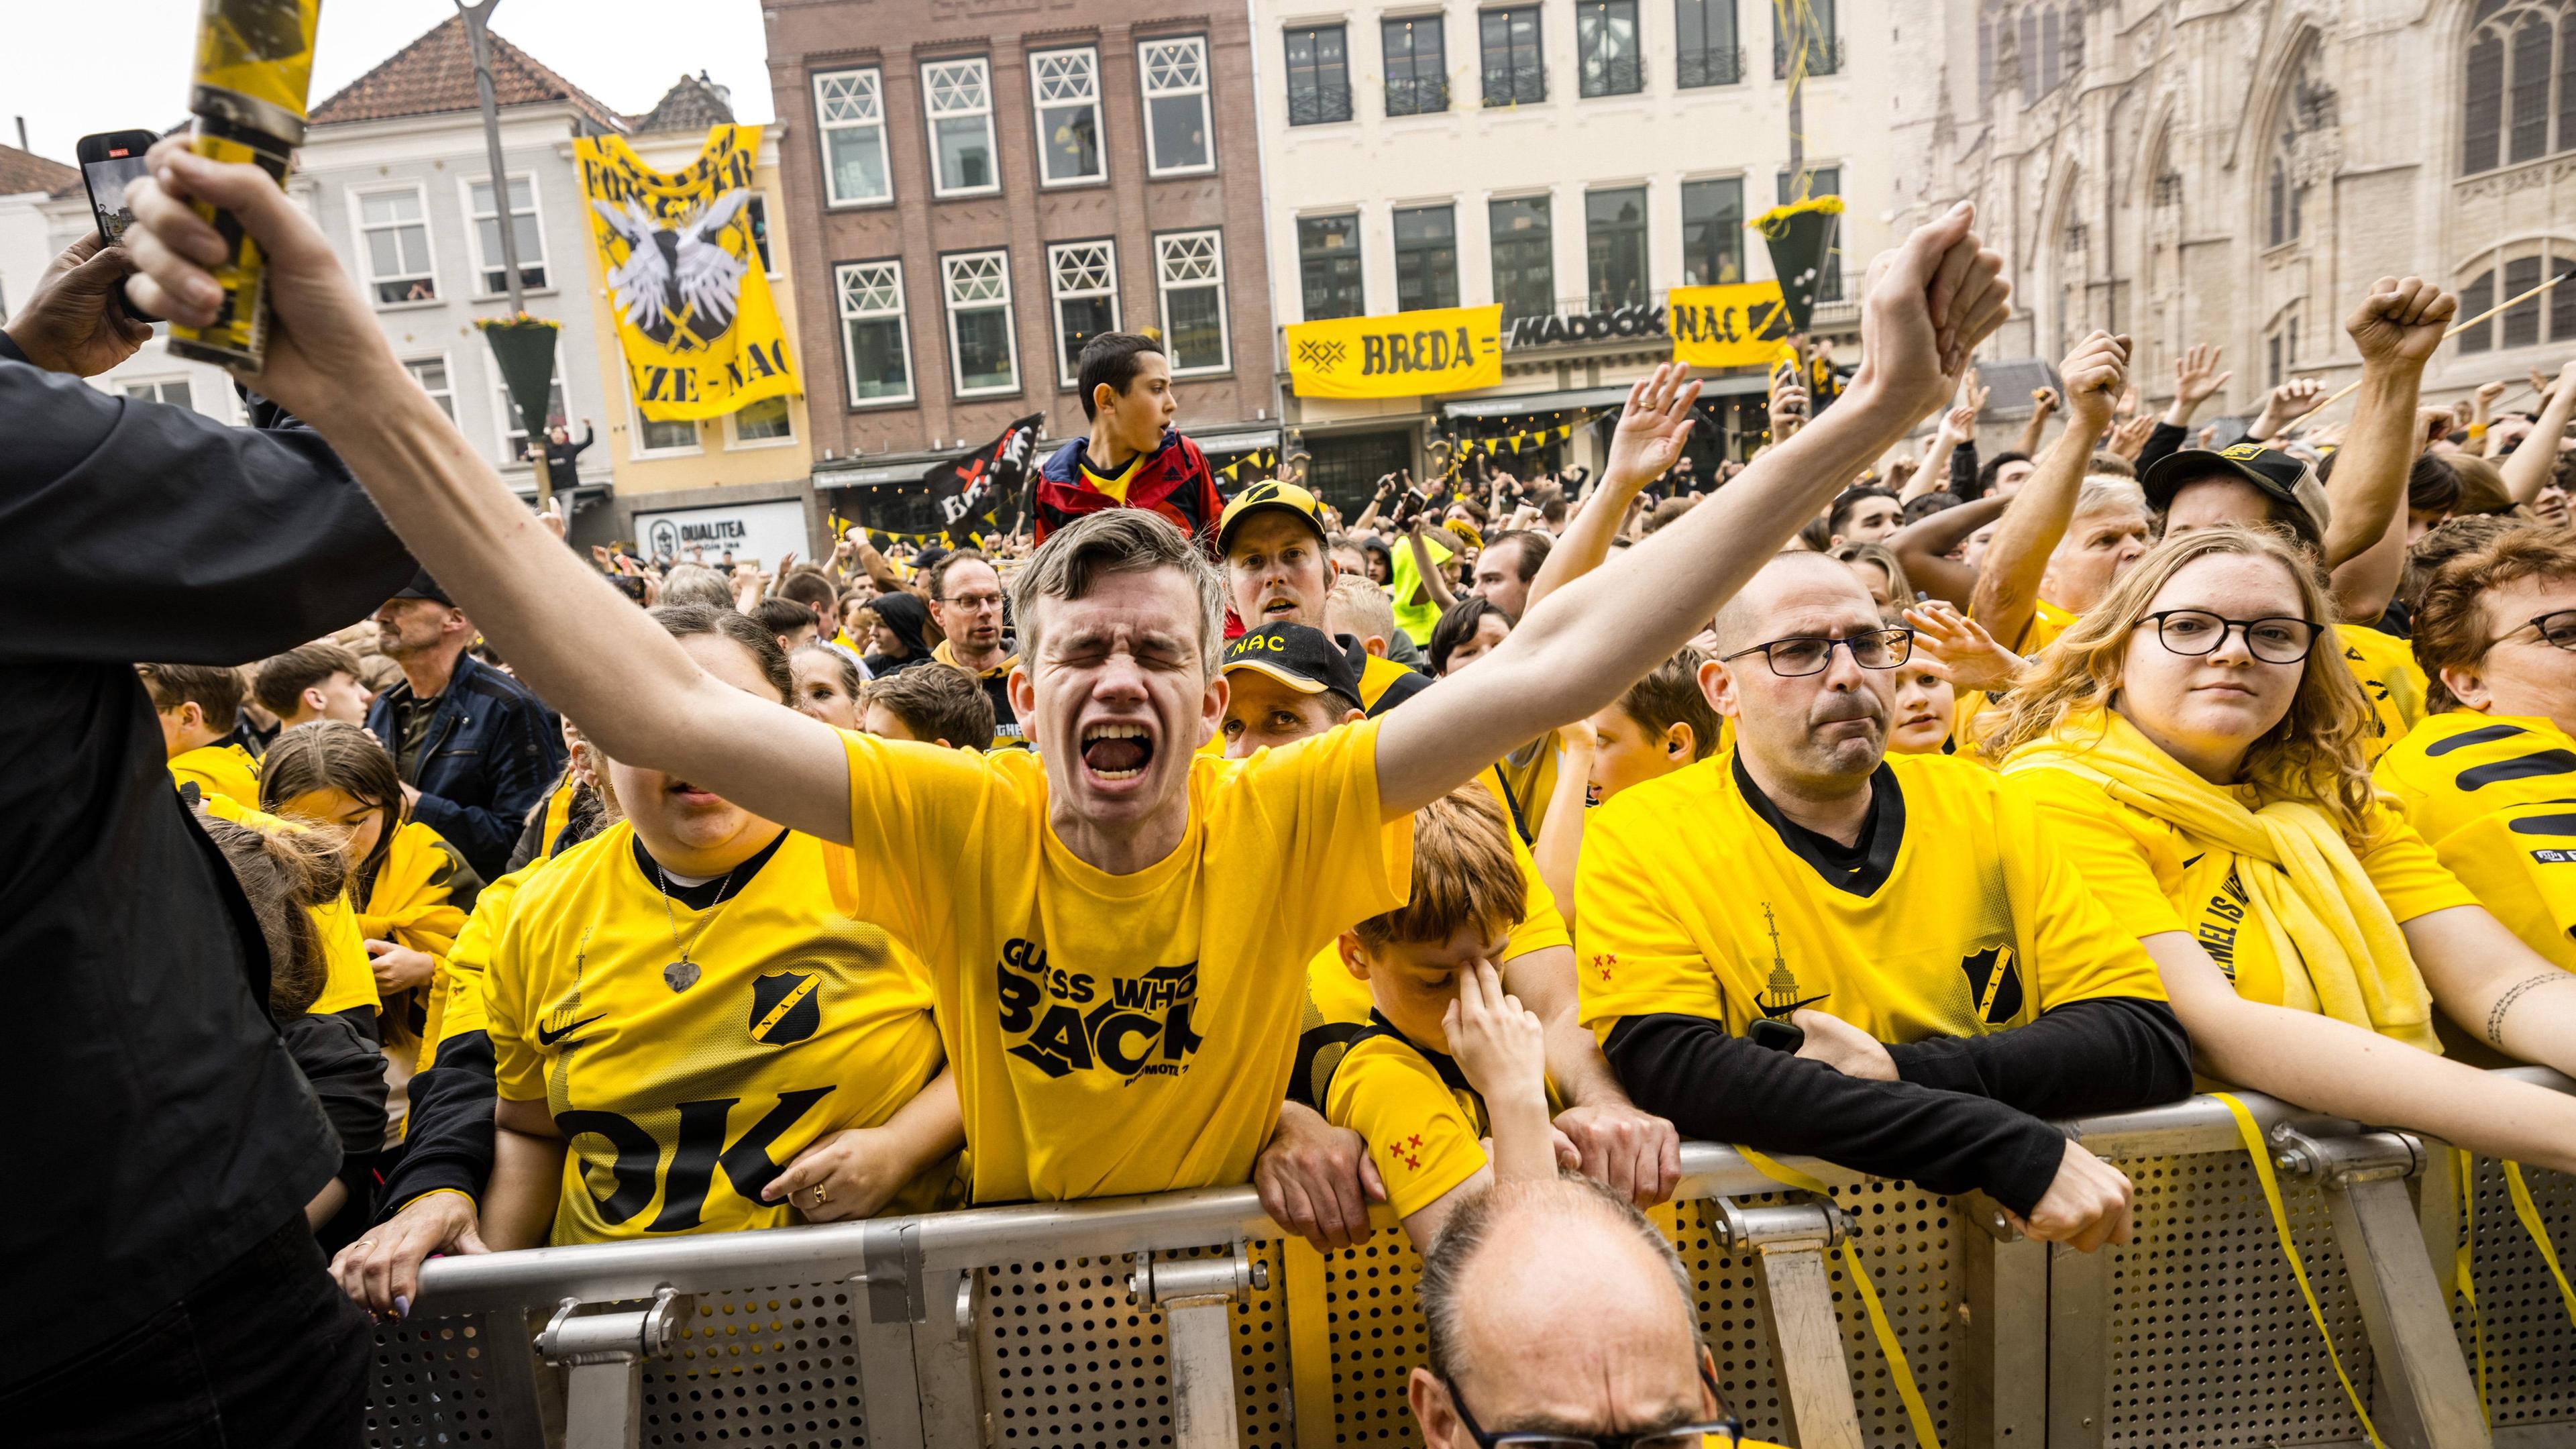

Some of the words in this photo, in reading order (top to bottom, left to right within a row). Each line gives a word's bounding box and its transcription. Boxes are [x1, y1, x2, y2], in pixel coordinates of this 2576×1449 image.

[1508, 304, 1665, 350] MADDOX
[1673, 305, 1742, 343] NAC
[1361, 327, 1474, 375] BREDA
[682, 520, 745, 541] QUALITEA
[1230, 634, 1285, 657] NAC
[2206, 896, 2245, 925] IS
[555, 1084, 837, 1232] OK
